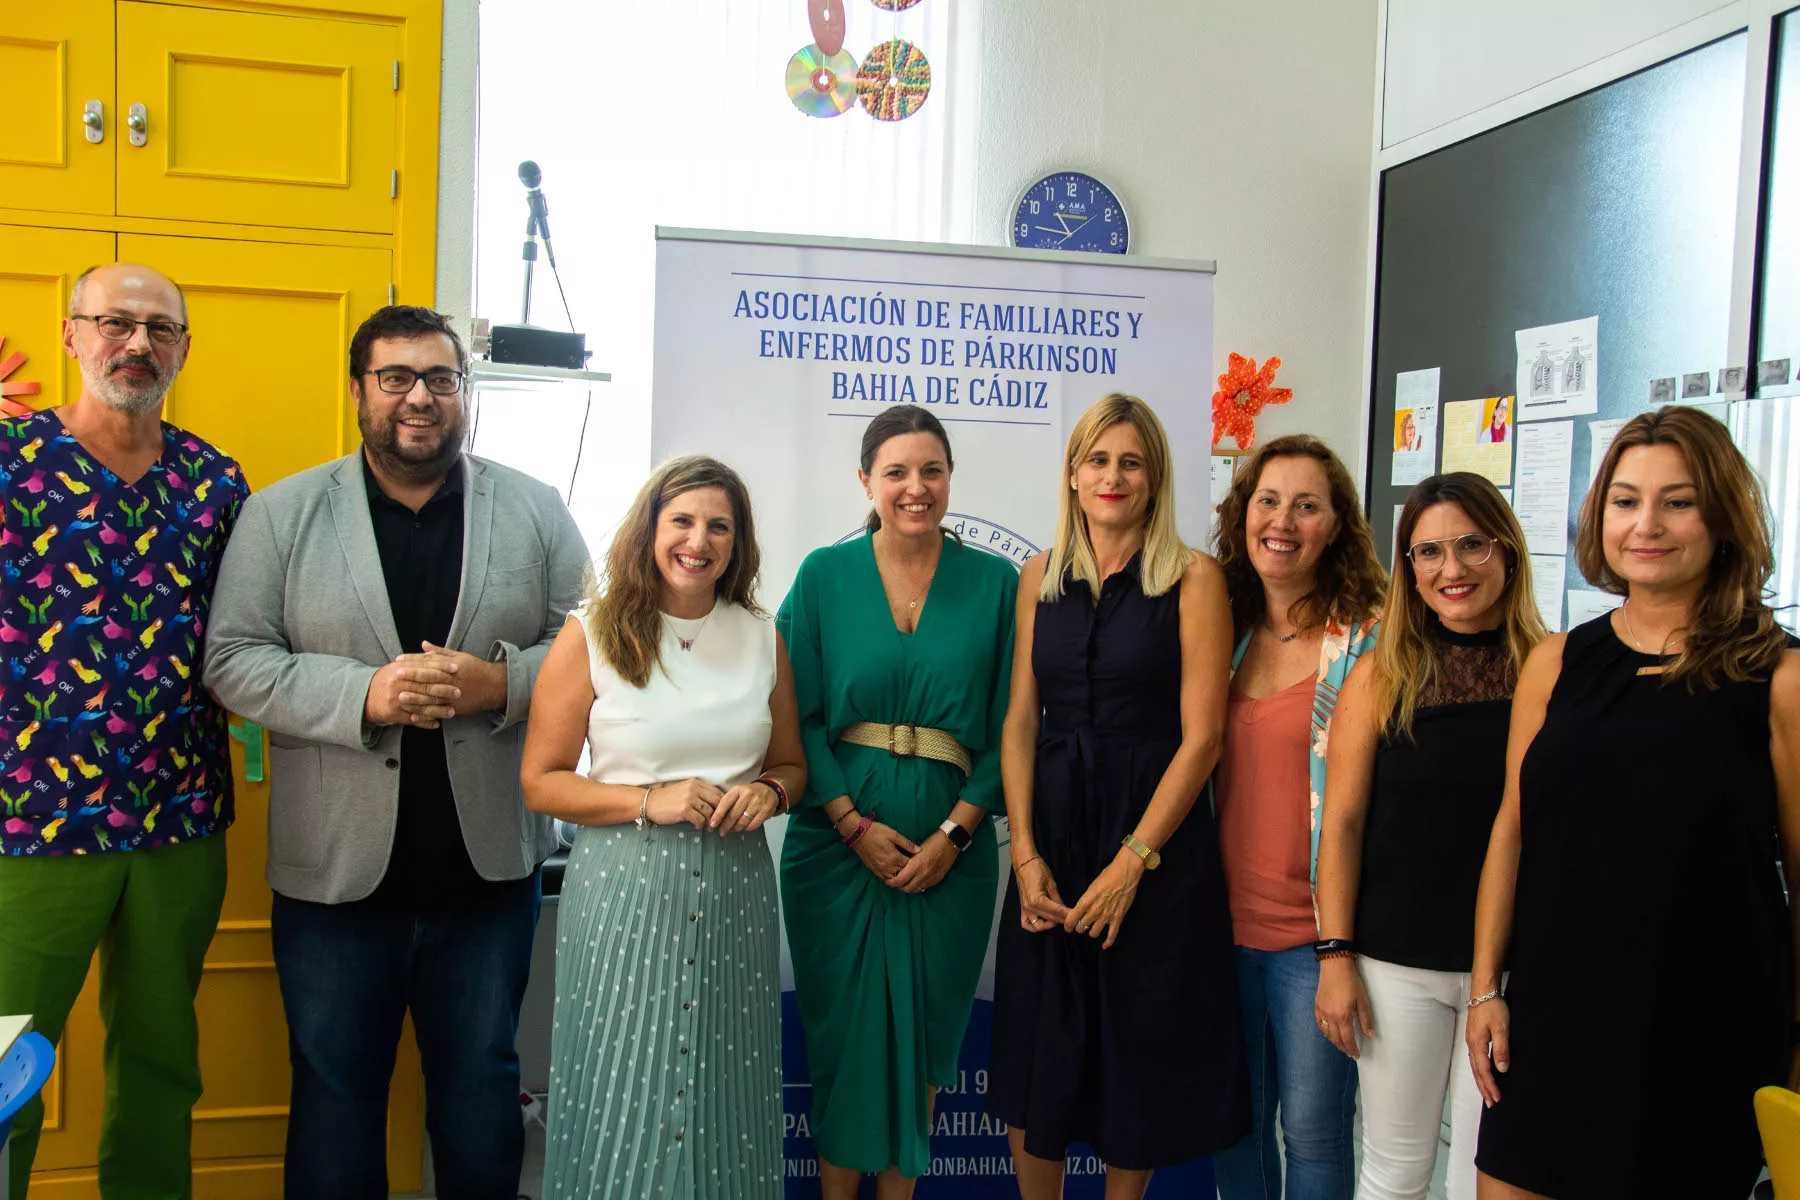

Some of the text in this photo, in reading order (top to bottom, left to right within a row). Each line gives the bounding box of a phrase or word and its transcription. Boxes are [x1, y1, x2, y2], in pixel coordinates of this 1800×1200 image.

[1045, 186, 1054, 202] 11
[1066, 182, 1077, 198] 12
[1089, 189, 1094, 205] 1
[1029, 200, 1040, 215] 10
[1104, 207, 1112, 223] 2
[1020, 223, 1028, 238] 9
[1110, 231, 1118, 246] 3
[733, 289, 1141, 339] ASOCIACIÓN DE FAMILIARES Y
[760, 329, 1117, 375] ENFERMOS DE PÁRKINSON
[832, 371, 1048, 409] BAHIA DE CÁDIZ
[48, 489, 65, 503] OK!
[954, 520, 1032, 562] de Párk
[55, 584, 72, 598] OK!
[58, 681, 75, 695] OK!
[33, 779, 50, 793] OK!
[783, 1157, 821, 1177] NID
